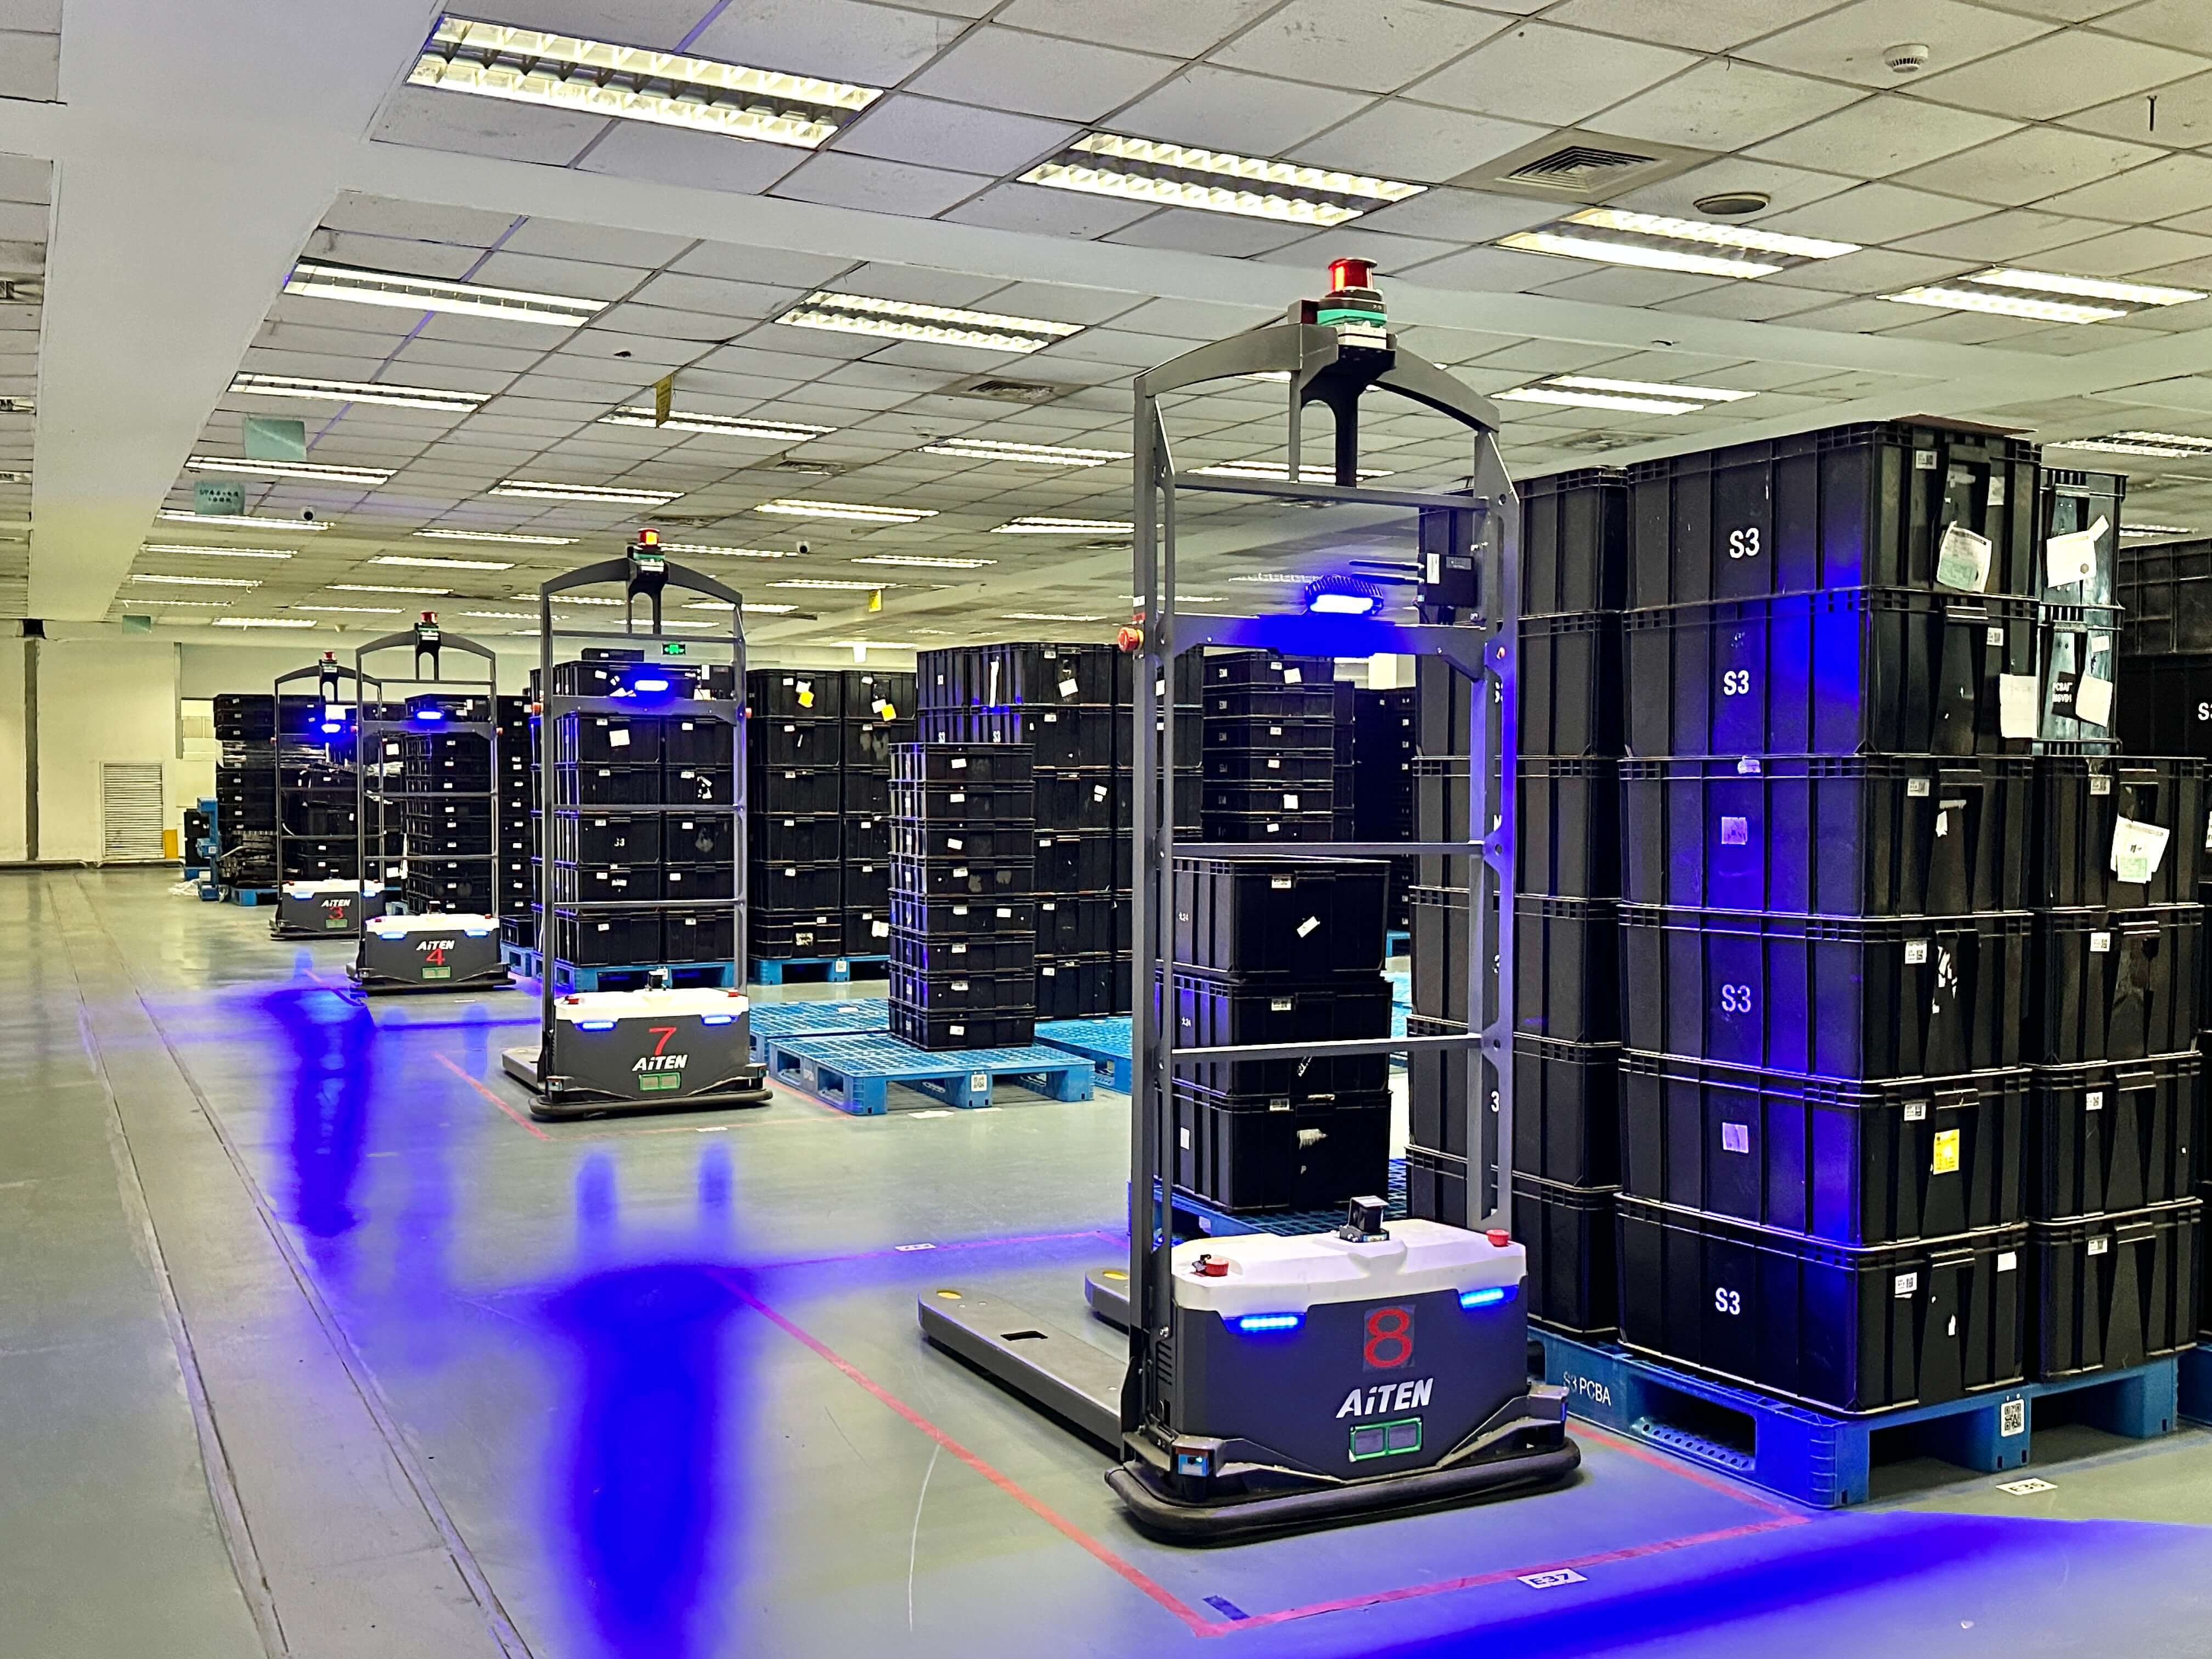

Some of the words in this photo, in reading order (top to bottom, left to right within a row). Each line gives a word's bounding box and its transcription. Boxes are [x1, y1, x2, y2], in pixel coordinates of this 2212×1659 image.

[1729, 527, 1760, 558] S3
[1723, 670, 1750, 696] S3
[2198, 702, 2212, 720] S
[329, 906, 344, 919] 3
[426, 947, 445, 966] 4
[1722, 984, 1751, 1013] S3
[648, 1026, 677, 1057] 7
[1715, 1287, 1741, 1315] S3
[1363, 1308, 1412, 1368] 8
[1335, 1377, 1434, 1419] AiTEN
[1562, 1370, 1578, 1393] S3
[1579, 1376, 1612, 1407] PCBA
[2008, 1482, 2045, 1492] E36
[1528, 1573, 1569, 1585] E37
